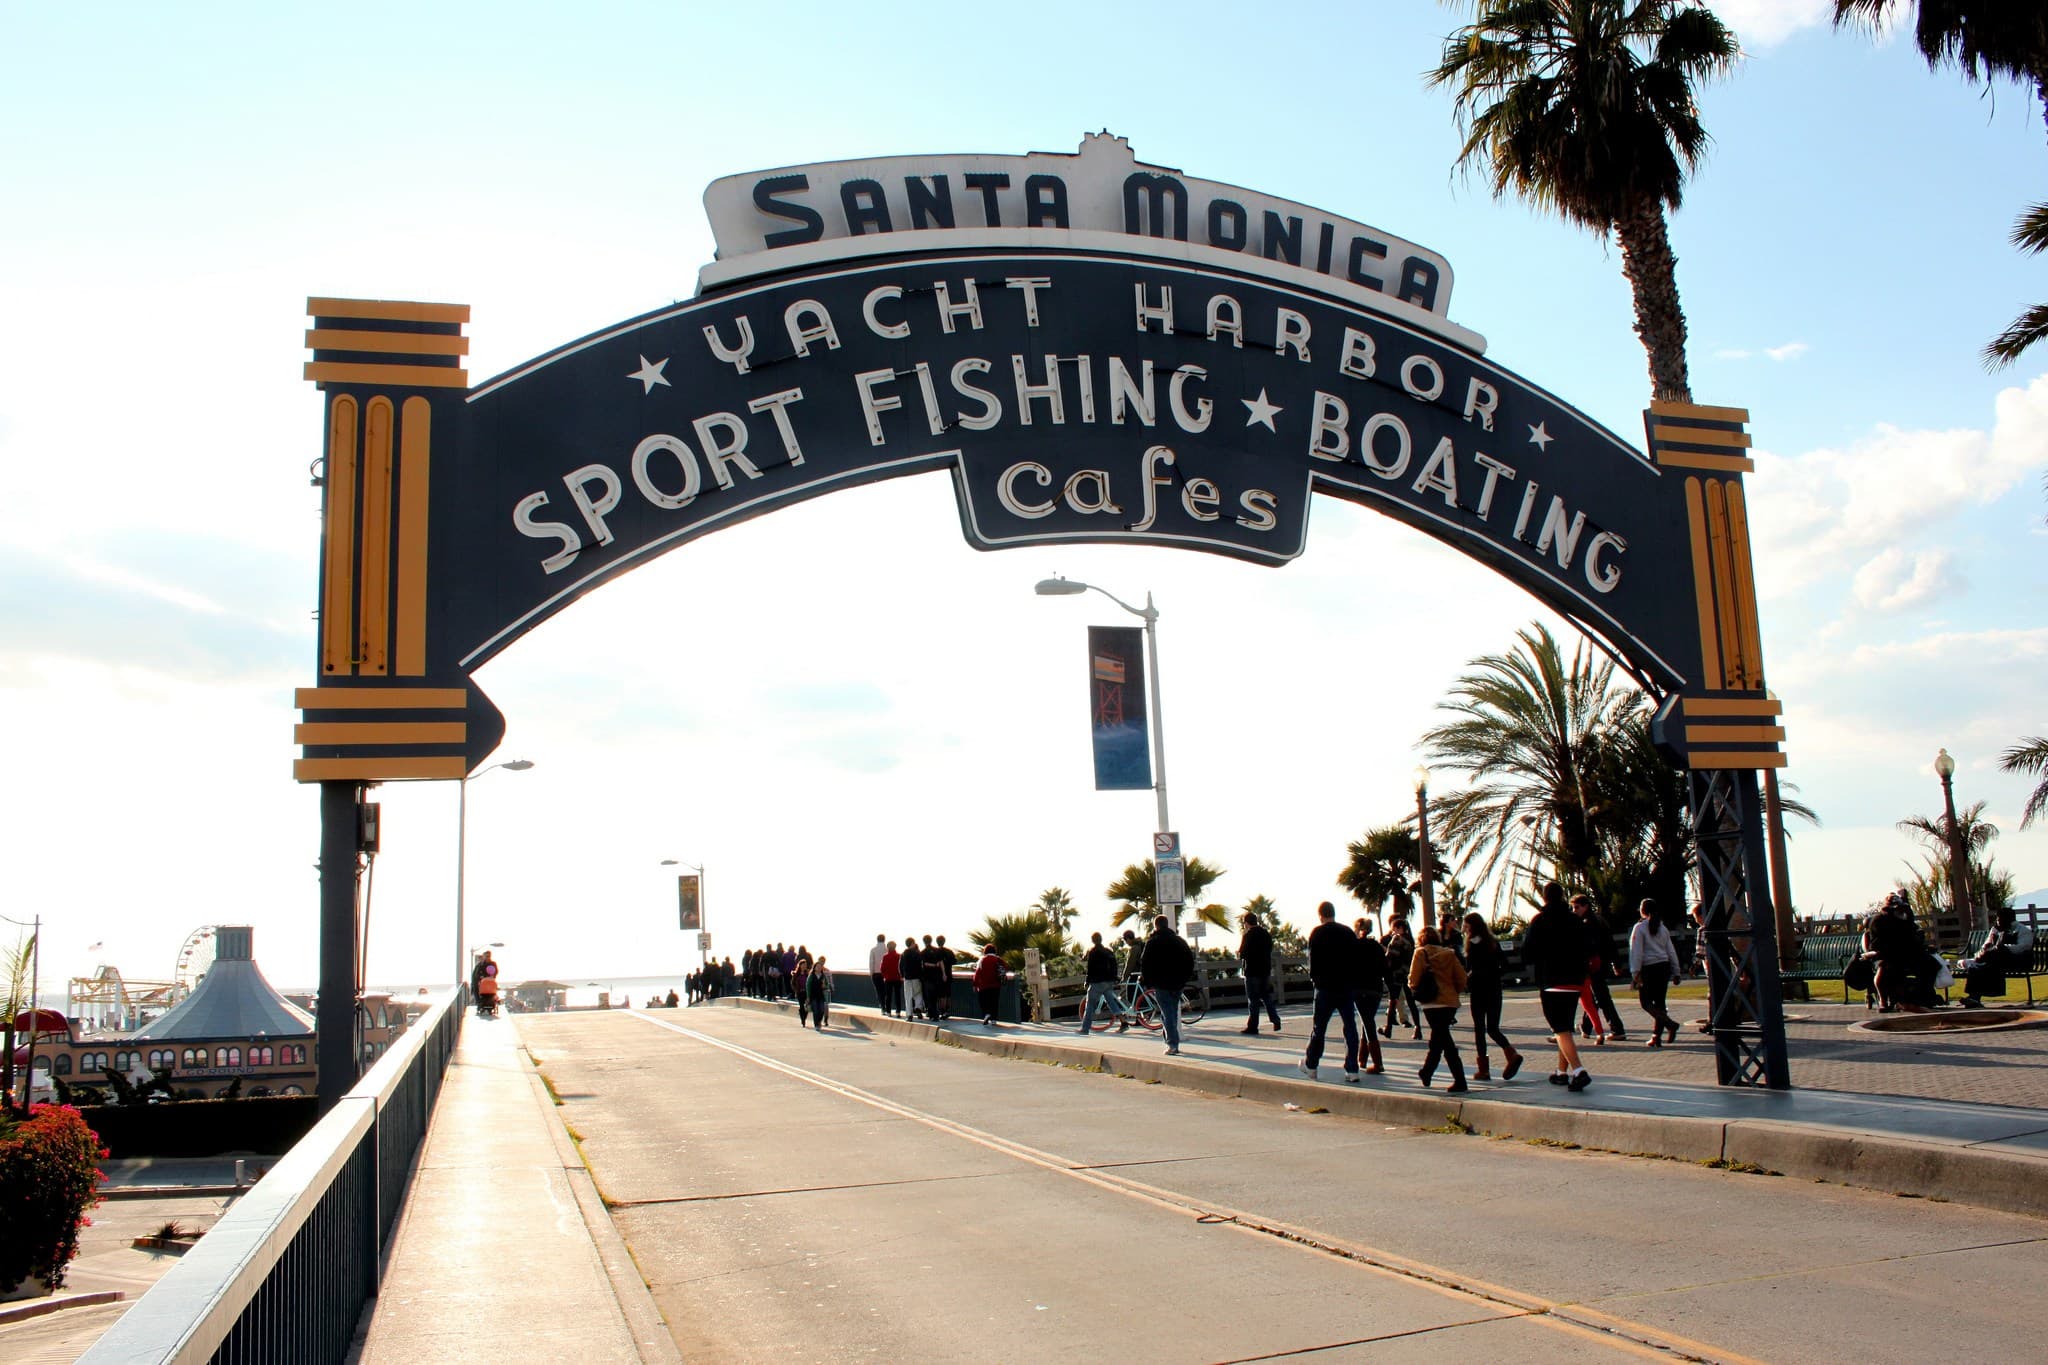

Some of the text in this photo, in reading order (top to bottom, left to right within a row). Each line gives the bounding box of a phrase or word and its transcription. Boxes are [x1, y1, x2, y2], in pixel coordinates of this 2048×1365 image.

[752, 171, 1440, 313] SANTA MONICA
[702, 276, 1501, 432] YACHT HARBOR
[512, 354, 1630, 594] SPORT FISHING BOATING
